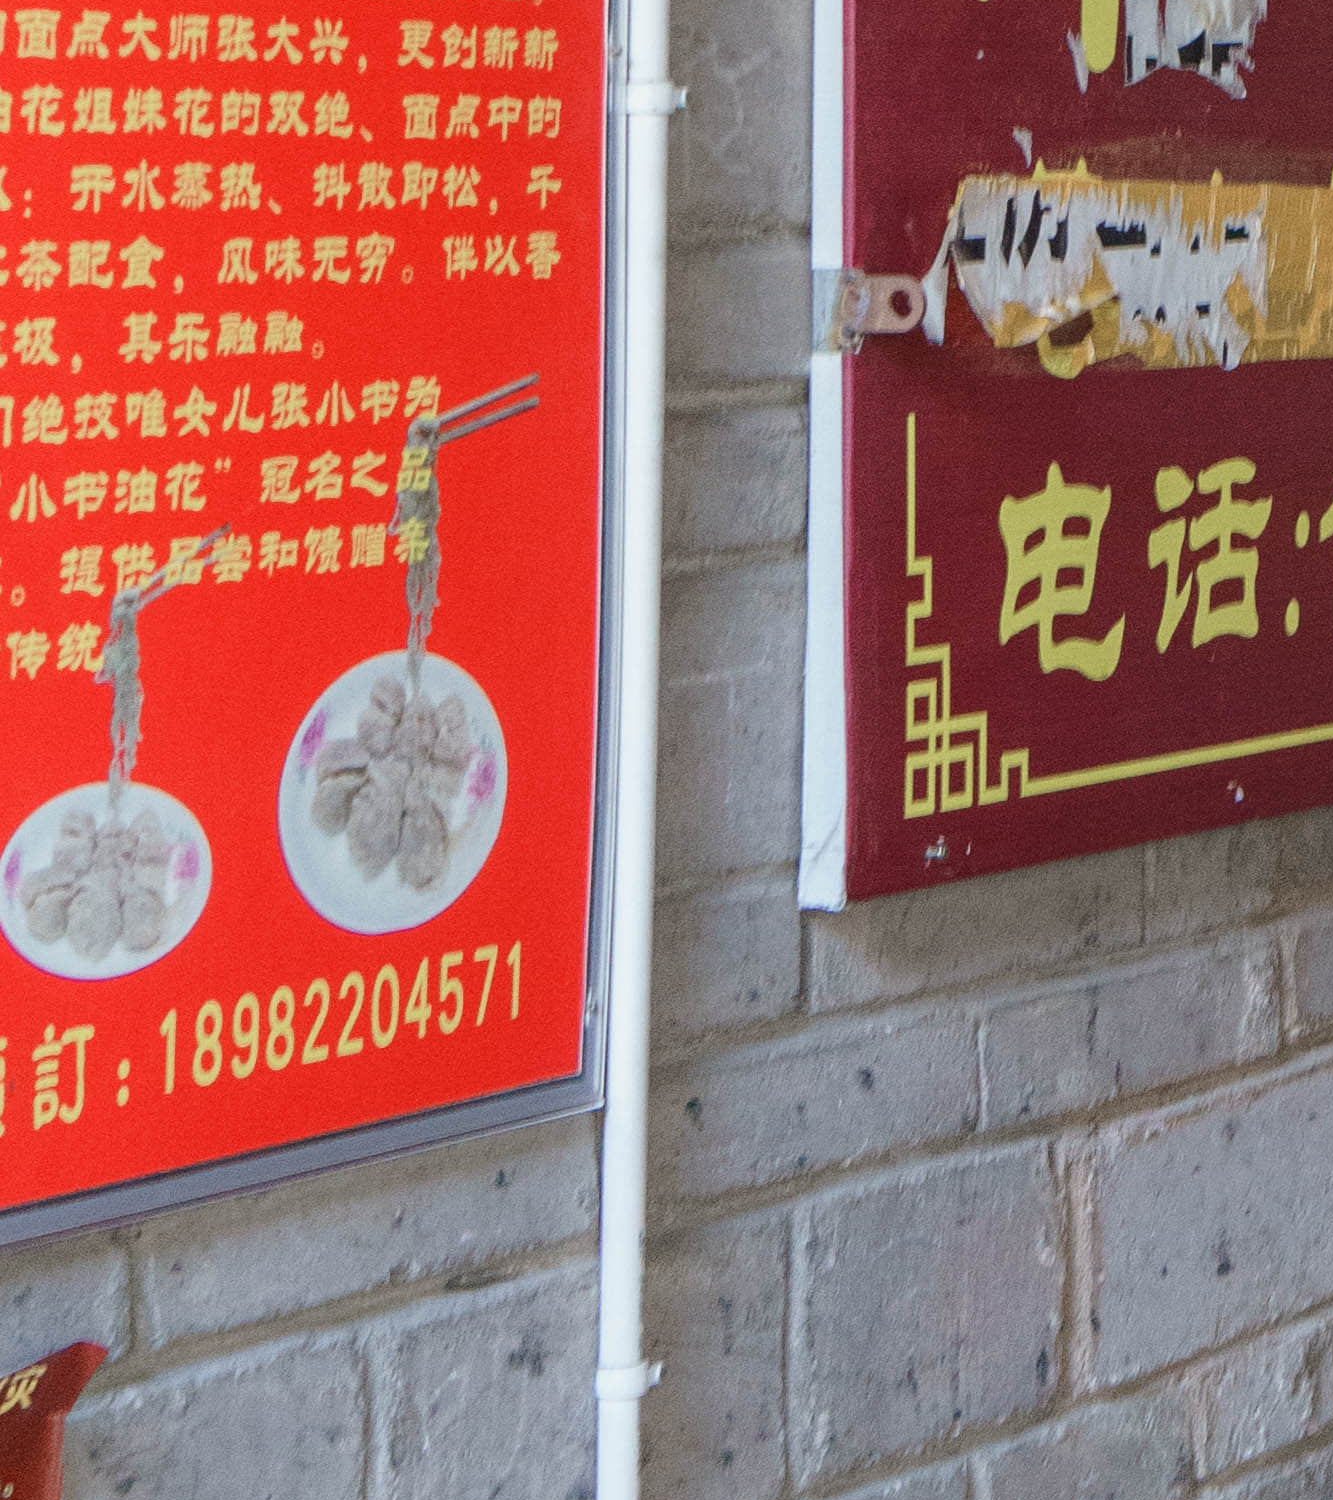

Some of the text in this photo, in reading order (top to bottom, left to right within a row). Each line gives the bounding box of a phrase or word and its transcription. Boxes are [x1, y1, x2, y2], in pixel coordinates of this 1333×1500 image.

[0, 8, 561, 75] 面点大师张大兴，更创新新
[0, 80, 563, 143] 花姐妹花的双绝、面点中的
[0, 158, 563, 217] ：开水蒸热、抖散即松，千
[0, 230, 563, 294] 茶配食，风味无穷。伴以香
[0, 308, 325, 375] 极，其乐融融。
[0, 374, 442, 449] 绝技唯女儿张小书为
[6, 620, 104, 681] 传统
